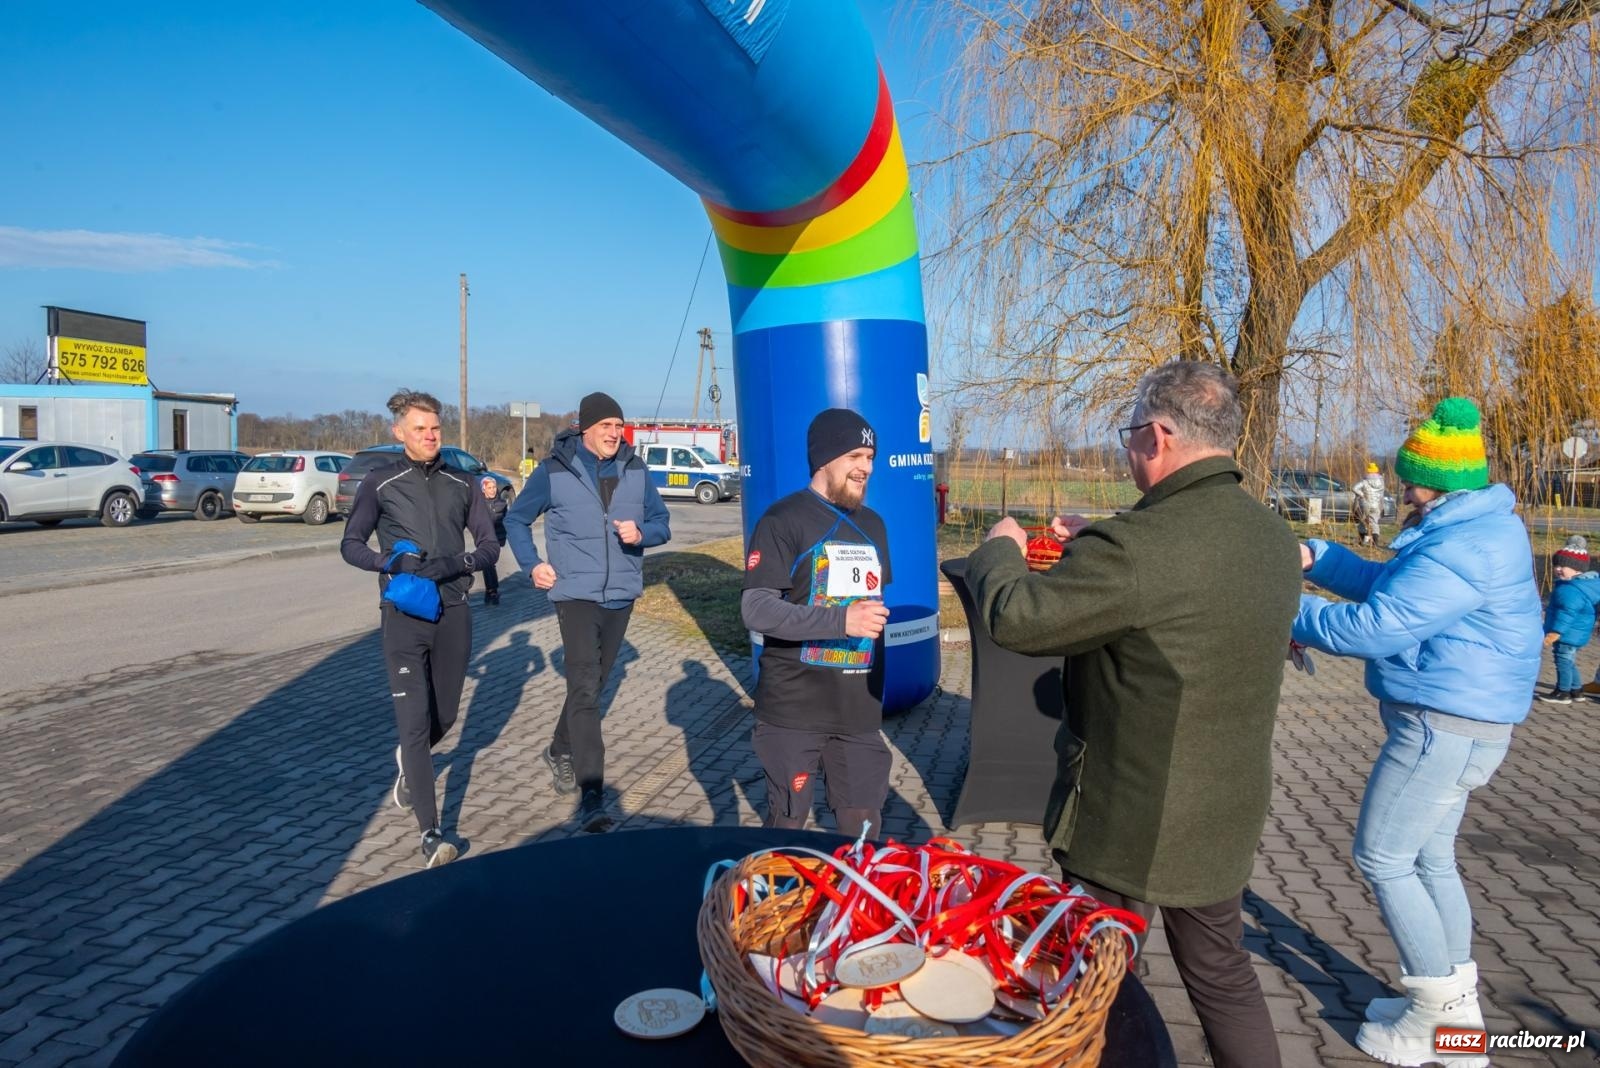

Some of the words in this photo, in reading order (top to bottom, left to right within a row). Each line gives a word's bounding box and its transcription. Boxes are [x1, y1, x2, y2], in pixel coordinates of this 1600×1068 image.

[73, 342, 103, 352] WYWÓZ
[105, 346, 133, 355] SZAMBA
[61, 351, 86, 368] 575
[92, 354, 117, 370] 792
[122, 358, 145, 373] 626
[889, 453, 923, 467] GMINA
[852, 567, 861, 583] 8
